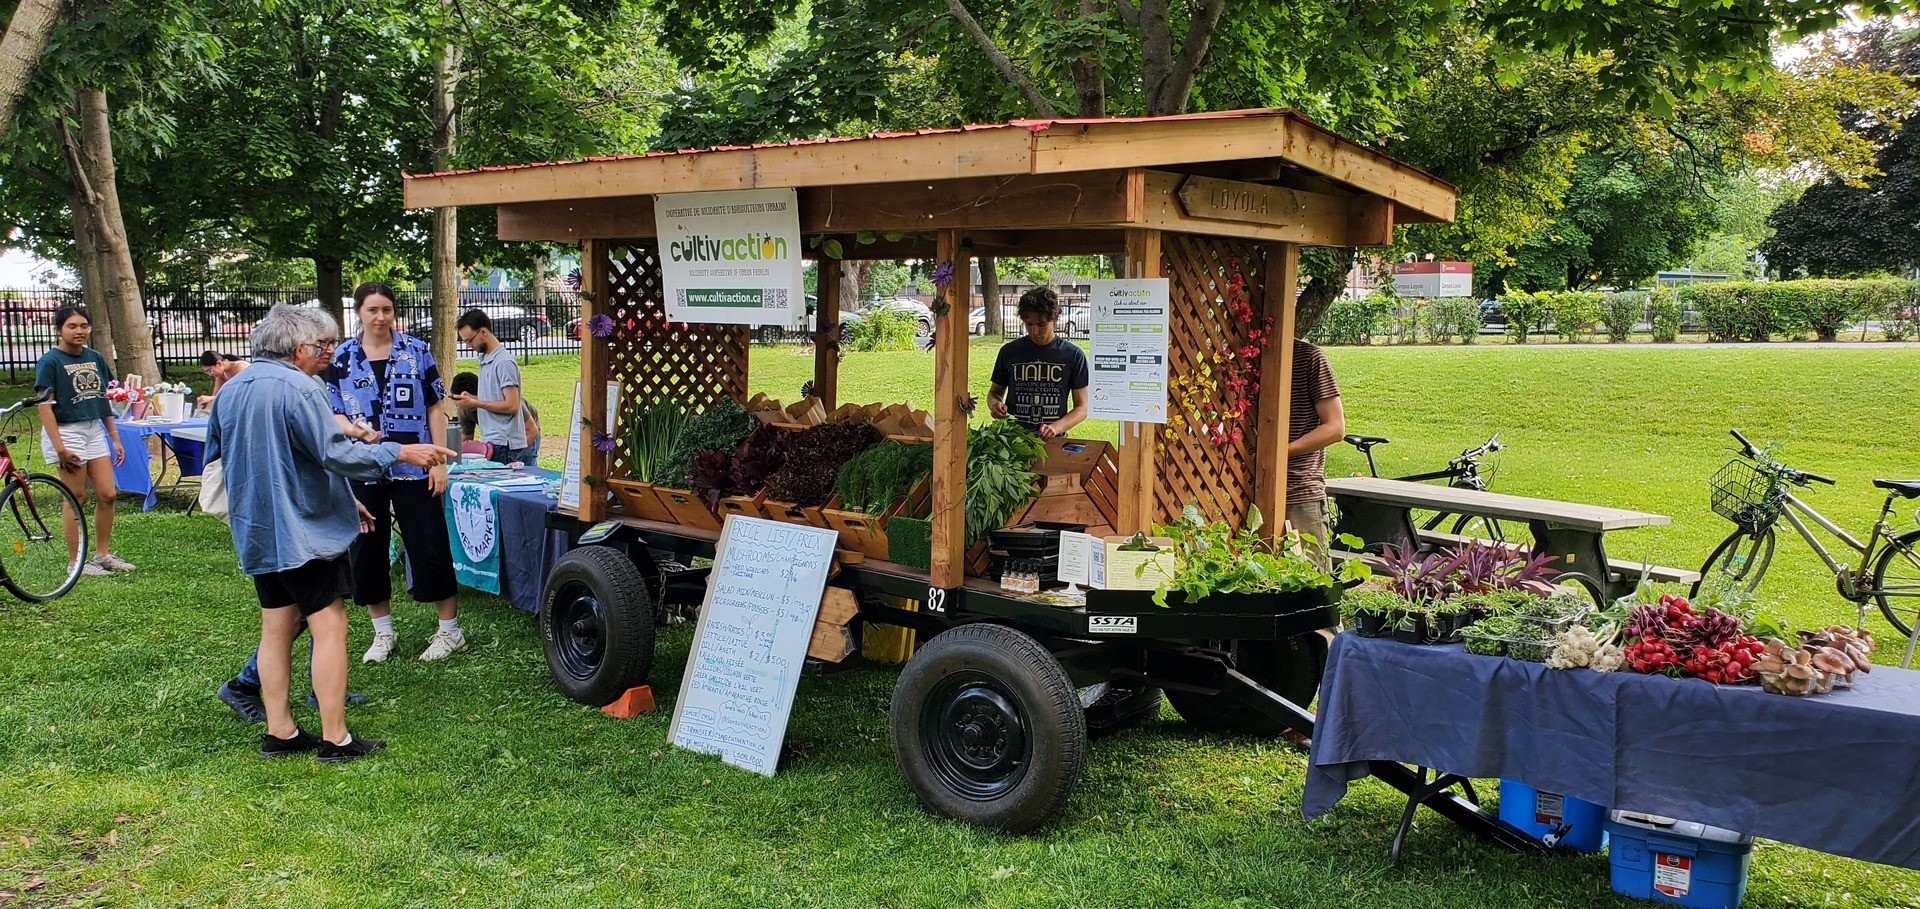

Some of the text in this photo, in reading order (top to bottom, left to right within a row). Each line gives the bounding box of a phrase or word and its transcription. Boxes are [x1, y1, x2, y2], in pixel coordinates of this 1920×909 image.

[1210, 188, 1268, 215] LOYOLA
[670, 232, 788, 262] cultivaction
[688, 291, 761, 303] www.cultivaction.ca
[1109, 288, 1151, 298] cultivaction
[1014, 364, 1062, 382] WAHC
[731, 520, 761, 541] PRICE
[716, 582, 735, 595] SALAD
[928, 587, 945, 612] 82
[1091, 617, 1134, 625] SSTA
[750, 686, 764, 695] VERT
[701, 713, 715, 722] CASH
